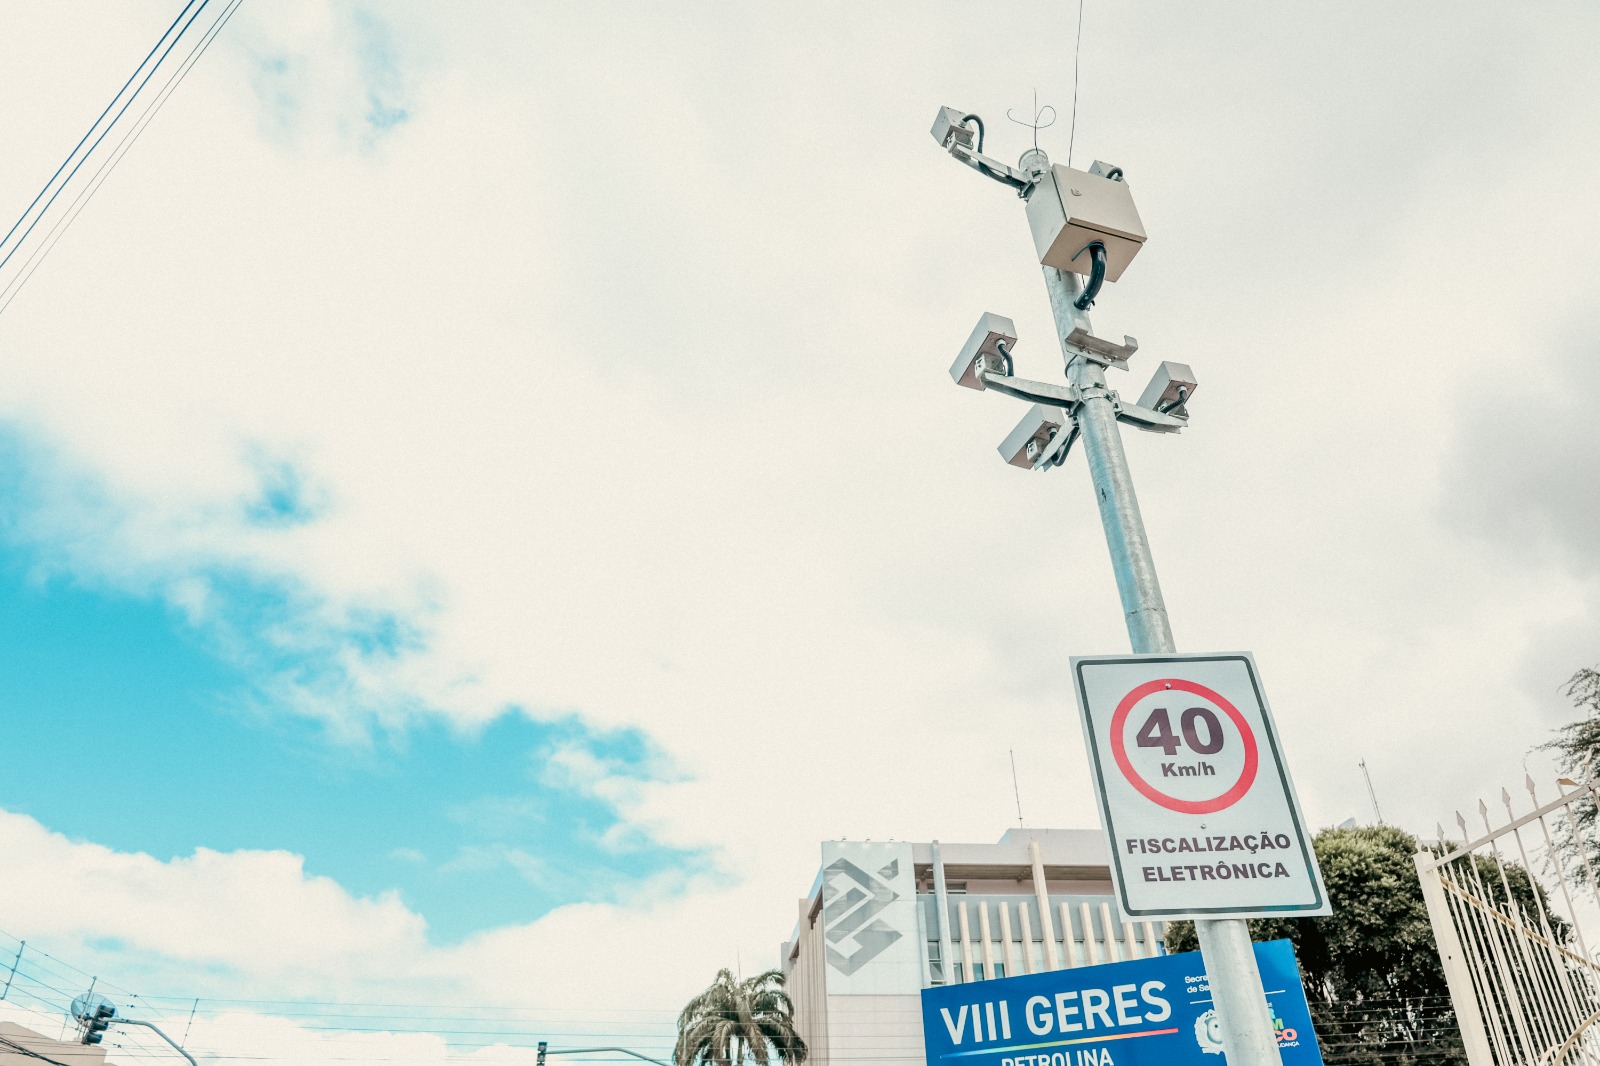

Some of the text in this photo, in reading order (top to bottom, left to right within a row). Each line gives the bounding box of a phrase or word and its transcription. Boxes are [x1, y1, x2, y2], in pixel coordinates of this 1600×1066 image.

[1136, 707, 1224, 756] 40
[1161, 761, 1216, 777] Km/h
[1126, 831, 1291, 854] FISCALIZAÇÃO
[1142, 860, 1290, 882] ELETRÔNICA
[940, 980, 1172, 1045] VIII GERES
